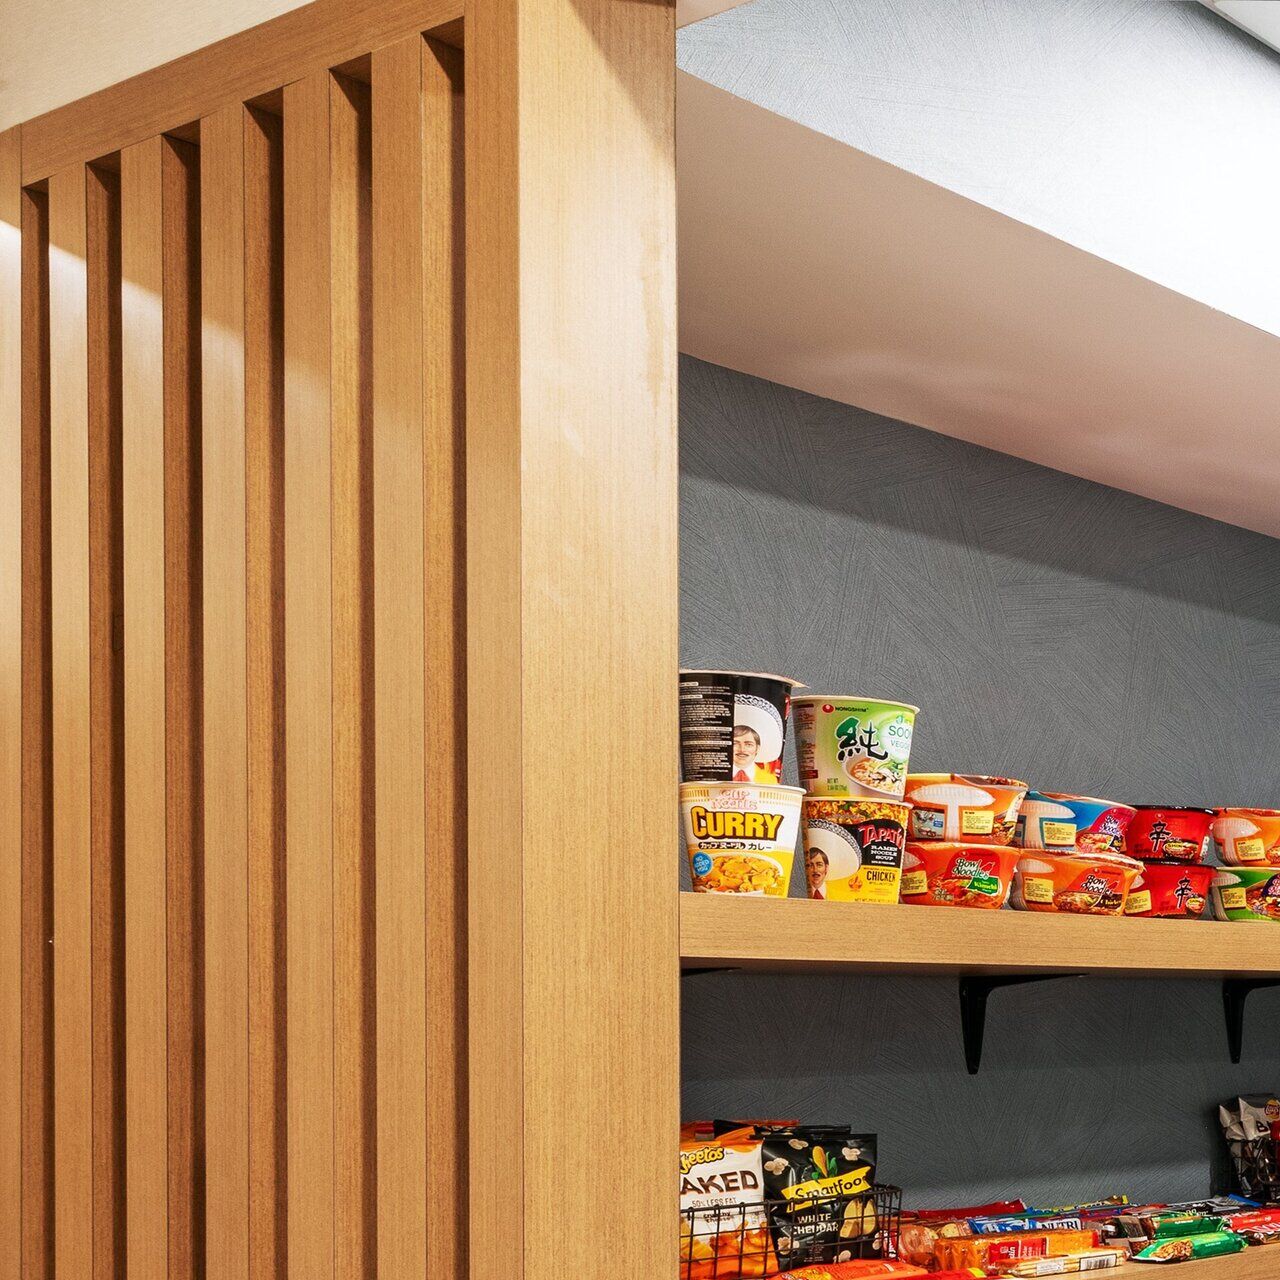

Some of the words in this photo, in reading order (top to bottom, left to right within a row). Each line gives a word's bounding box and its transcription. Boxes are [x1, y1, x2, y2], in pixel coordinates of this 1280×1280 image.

[888, 725, 912, 740] SOO
[691, 806, 784, 841] CURRY
[1149, 820, 1172, 852] 辛
[956, 857, 981, 870] Bowl
[866, 870, 896, 882] CHICKEN
[681, 1170, 759, 1195] AKED
[706, 1198, 723, 1206] LESS
[724, 1196, 737, 1205] FAT
[798, 1212, 832, 1224] WHITE
